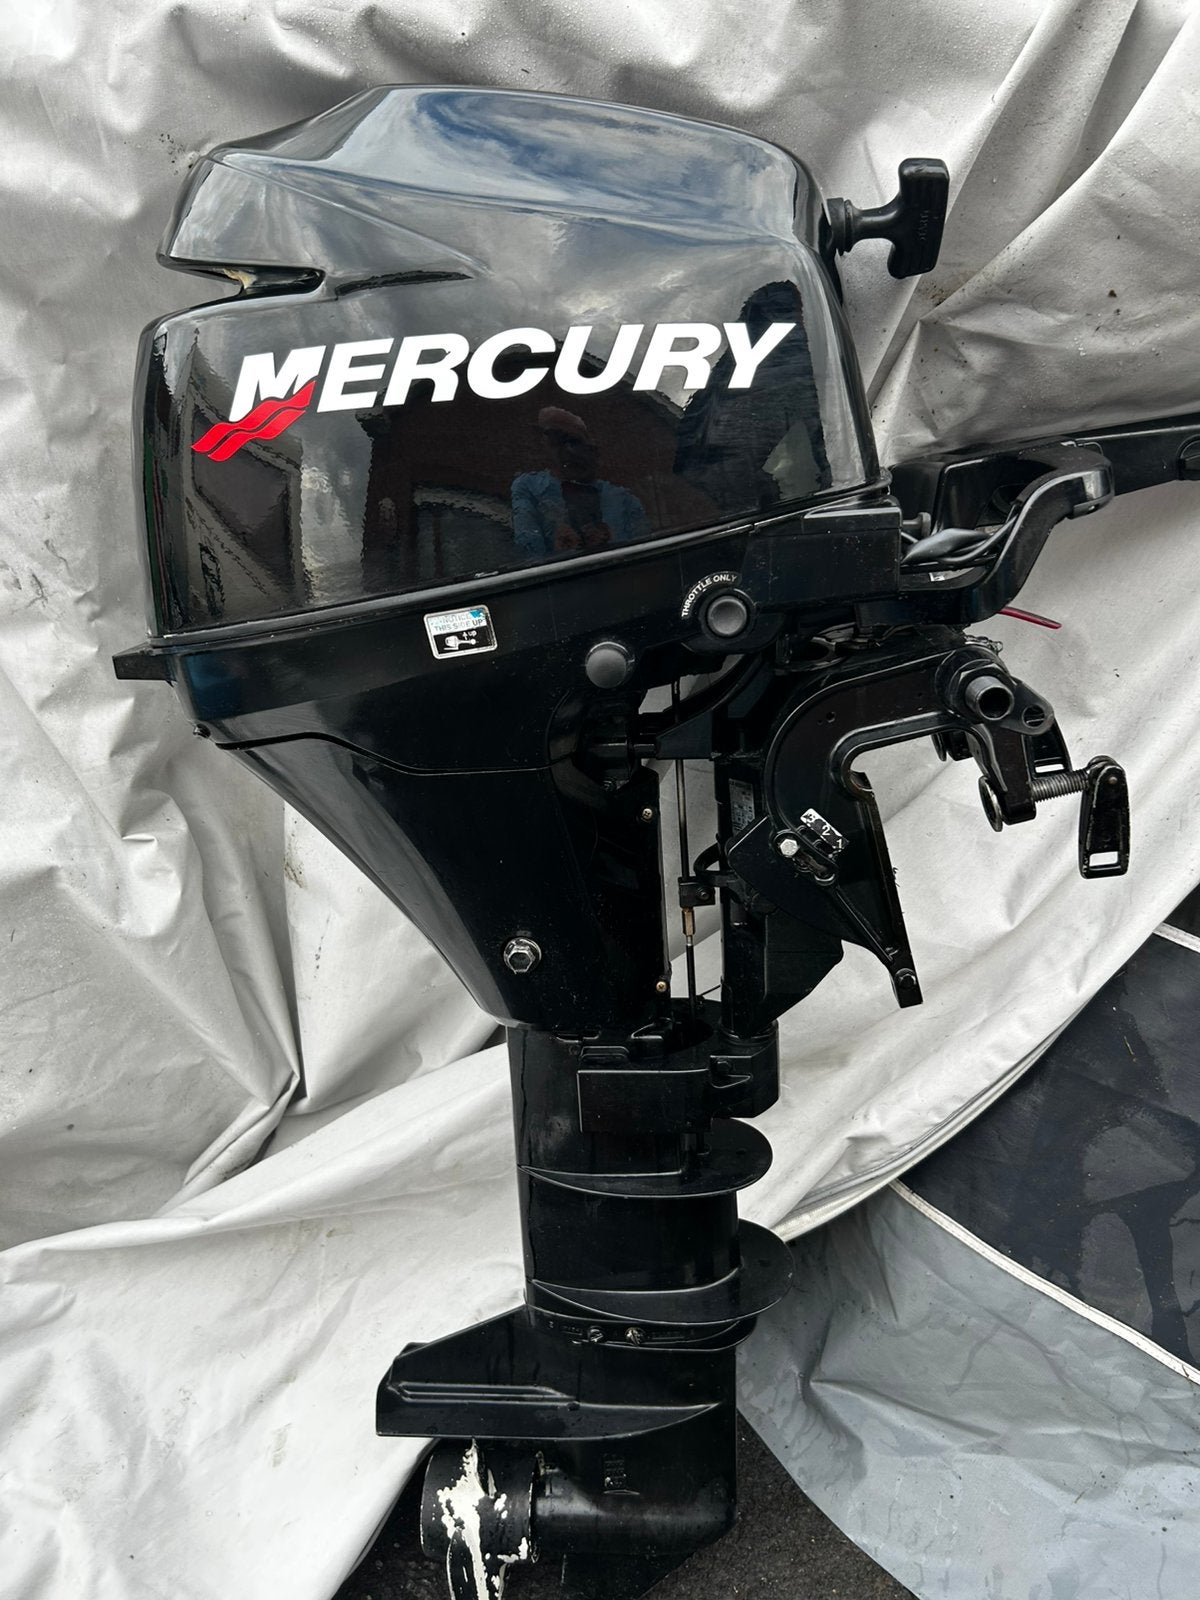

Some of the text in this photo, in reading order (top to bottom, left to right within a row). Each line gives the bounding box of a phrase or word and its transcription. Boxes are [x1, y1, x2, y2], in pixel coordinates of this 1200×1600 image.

[229, 322, 797, 423] MERCURY
[681, 574, 738, 618] THROTTLE ONLY
[434, 618, 484, 632] THIS SIDE UP
[821, 824, 831, 836] 2
[836, 838, 843, 849] 1
